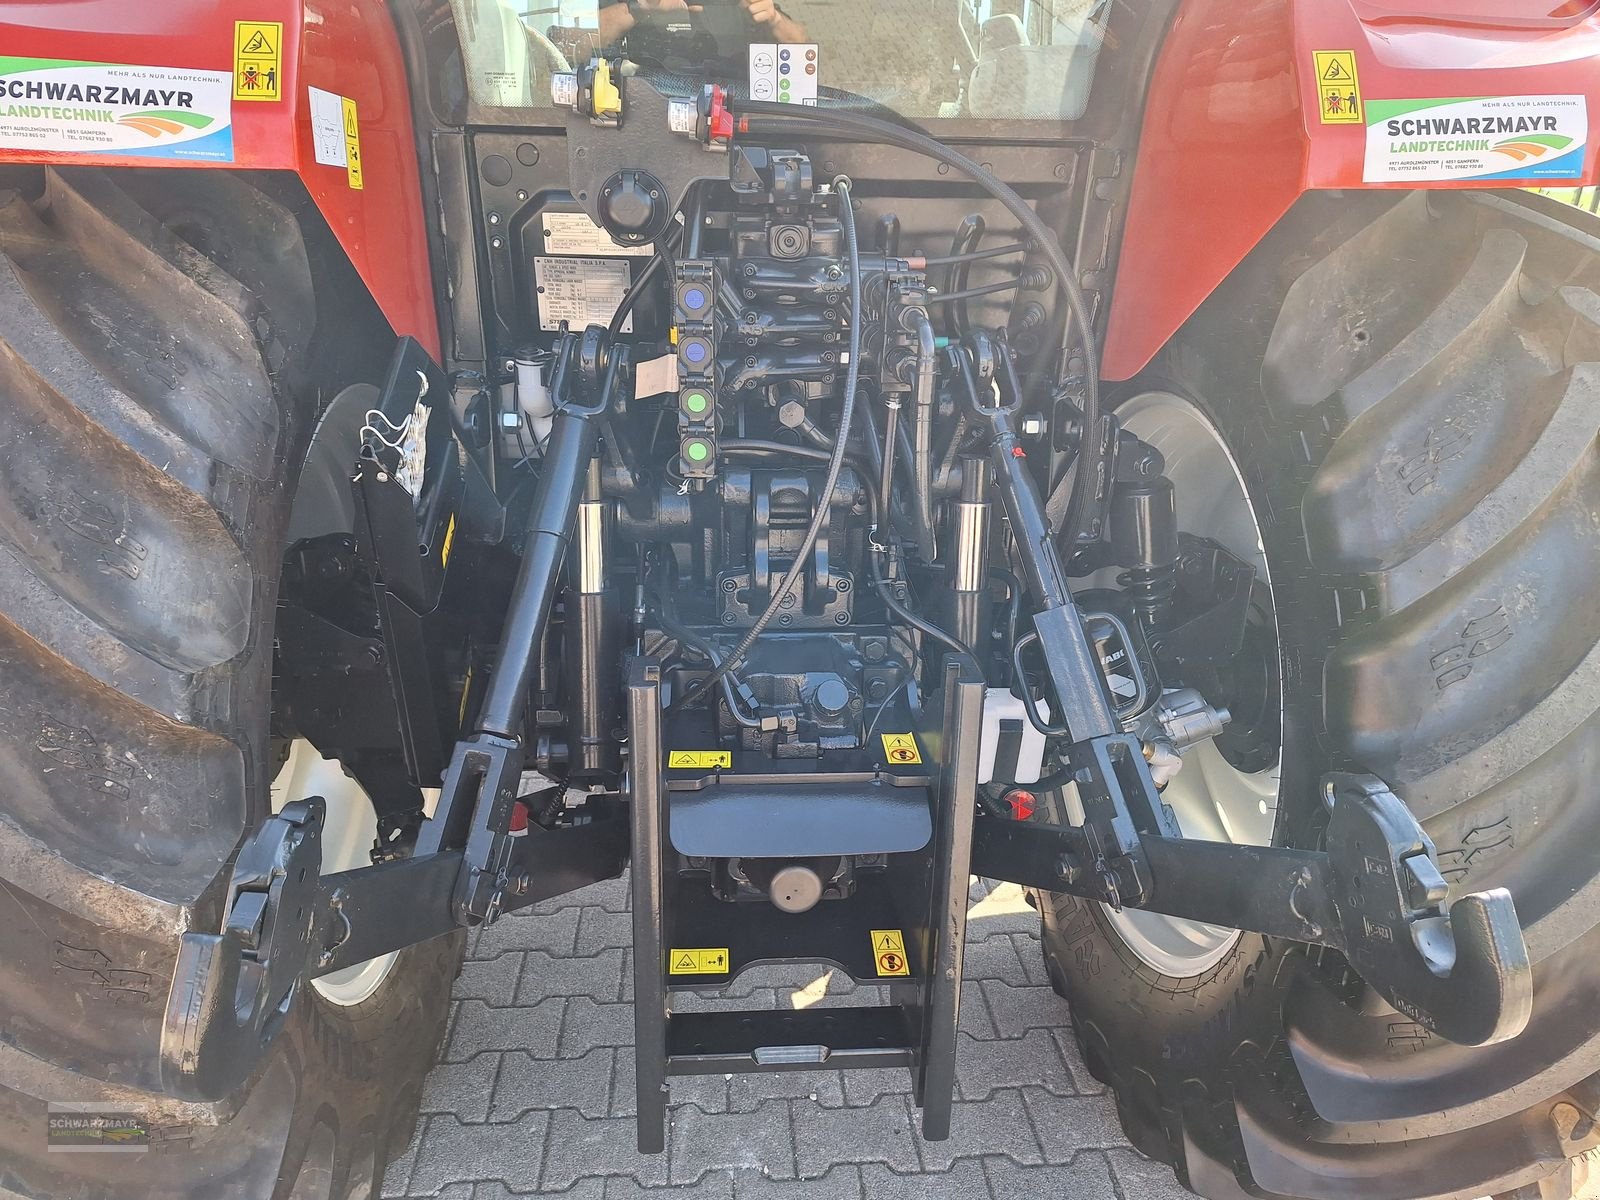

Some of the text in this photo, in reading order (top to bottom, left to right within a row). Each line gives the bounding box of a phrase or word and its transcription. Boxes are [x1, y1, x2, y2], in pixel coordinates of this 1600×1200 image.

[168, 74, 223, 84] LANDTECHNIK.
[0, 104, 114, 123] LANDTECHNIK
[1388, 116, 1557, 136] SCHWARZMAYR
[1390, 139, 1490, 153] LANDTECHNIK
